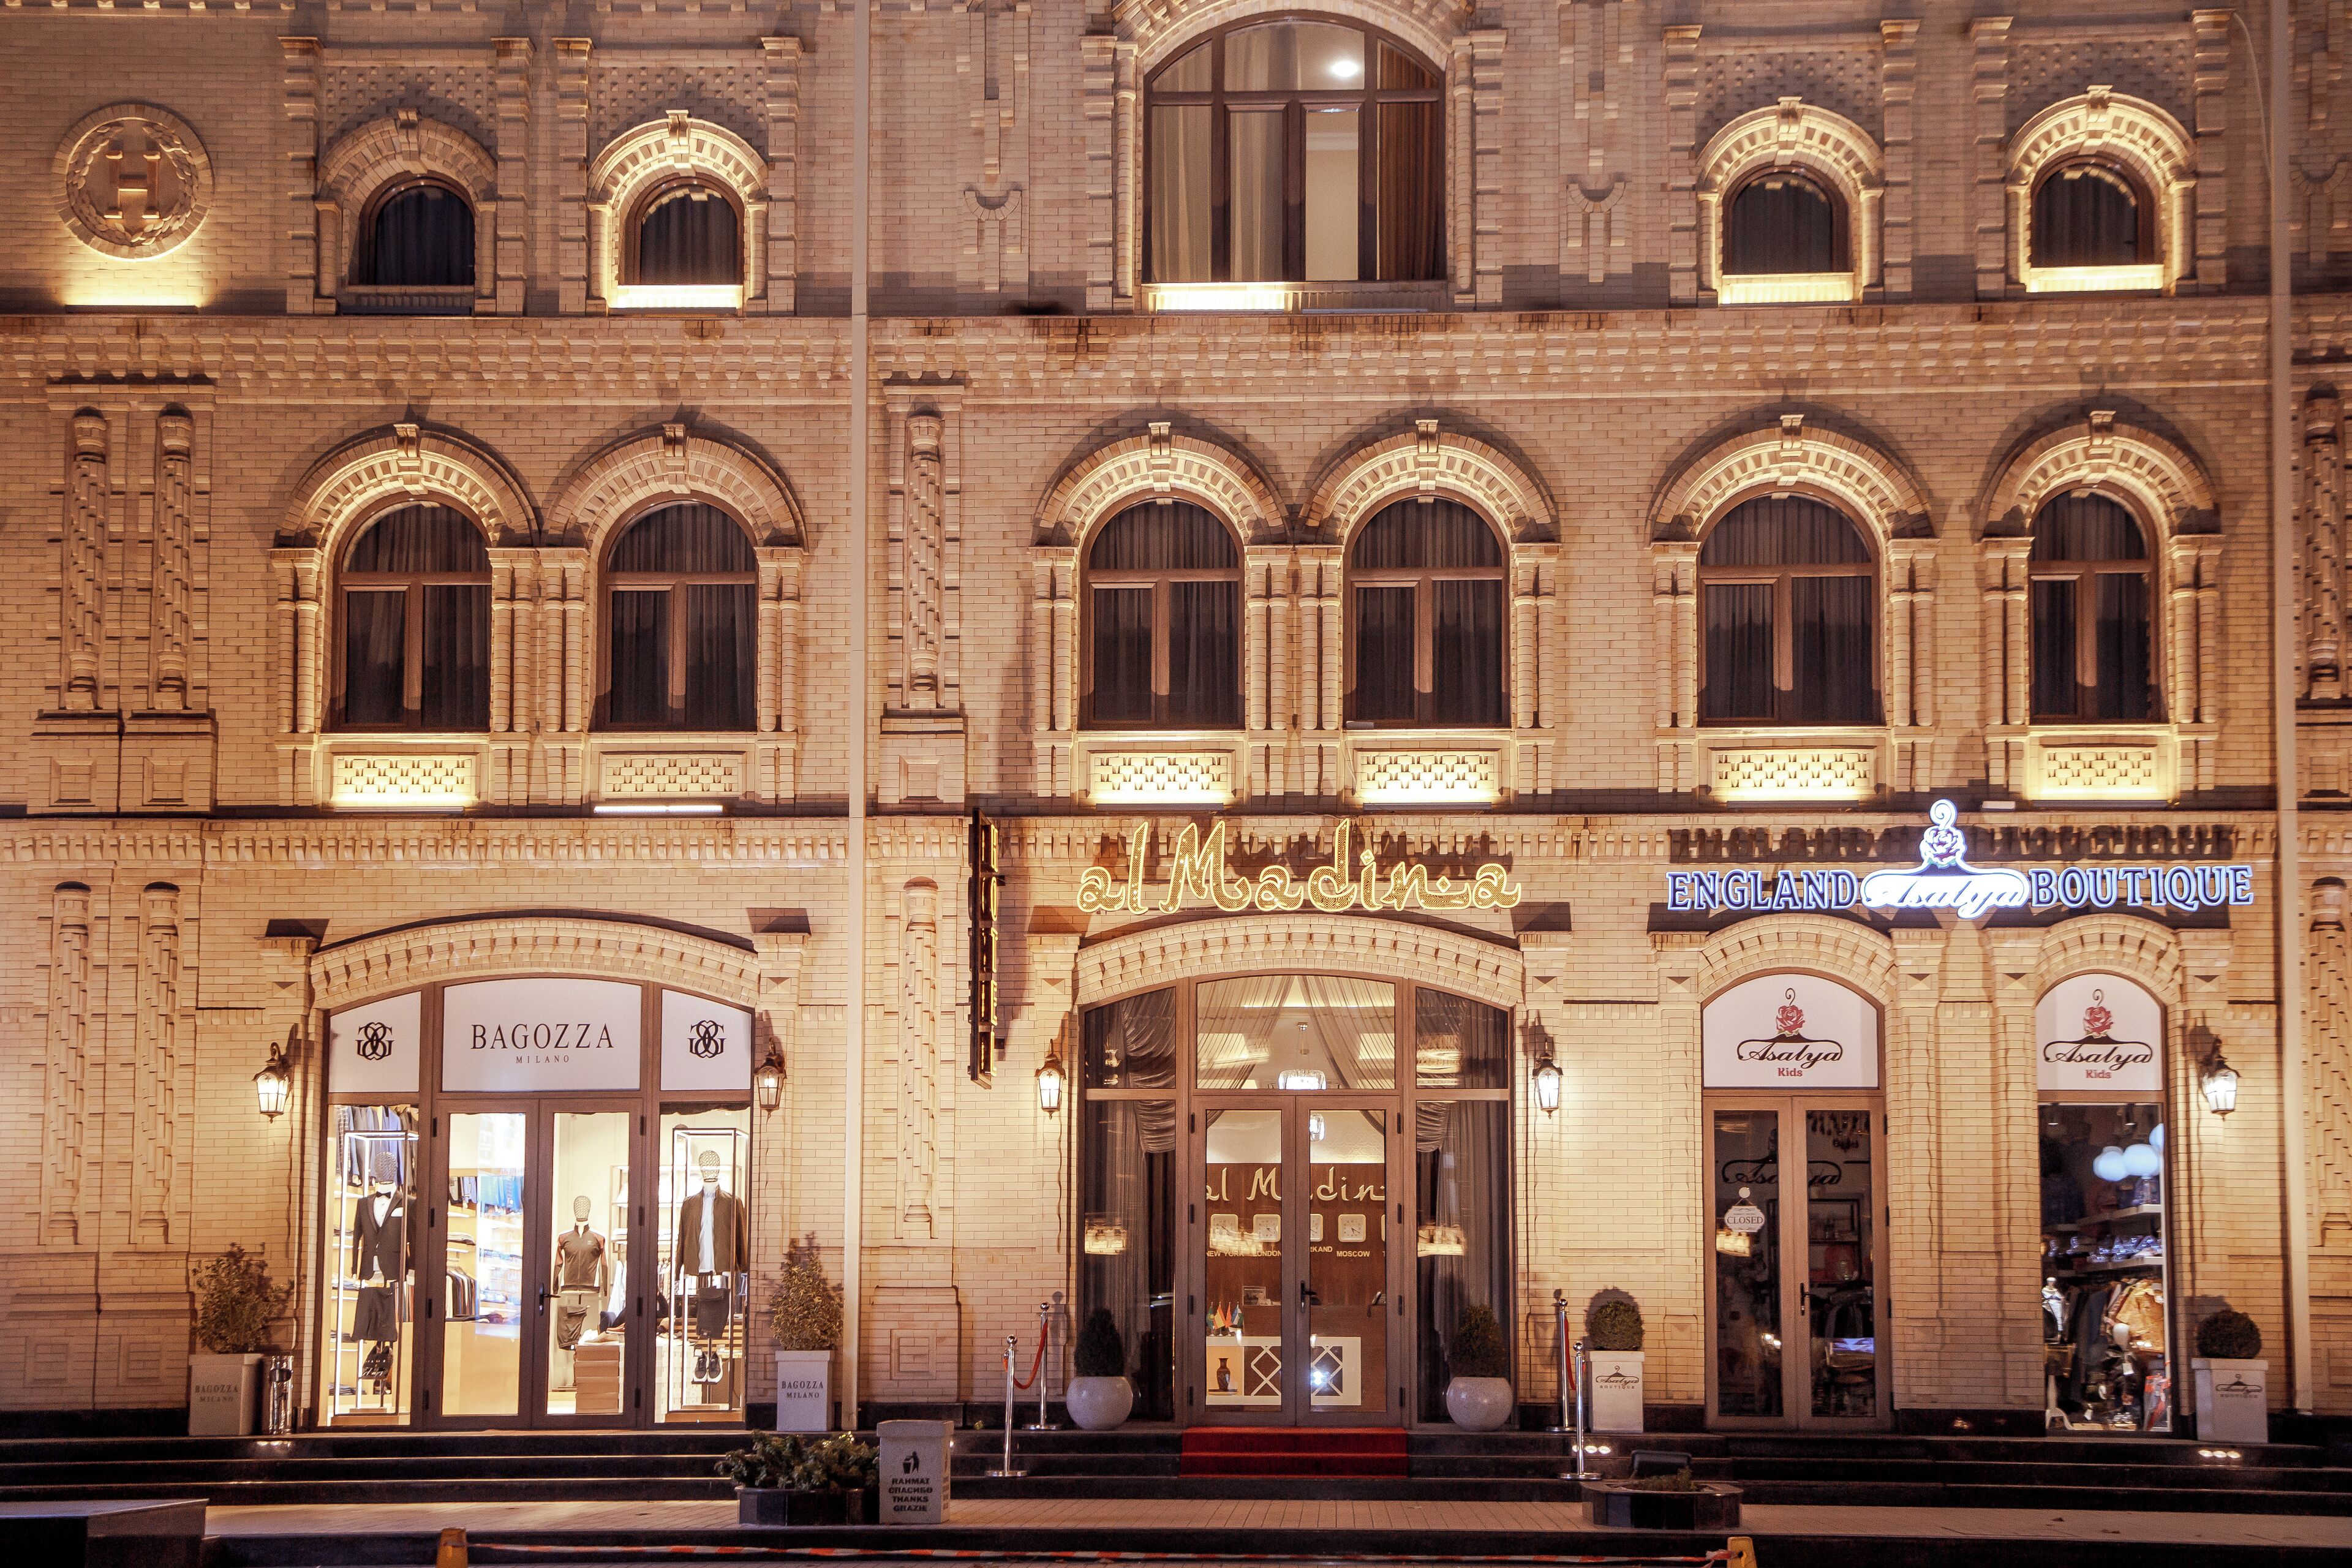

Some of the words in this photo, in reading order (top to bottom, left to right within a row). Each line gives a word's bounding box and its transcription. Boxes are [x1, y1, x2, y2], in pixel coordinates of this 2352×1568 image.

[1666, 869, 1860, 911] ENGLAND
[2029, 865, 2254, 911] BOUTIQUE
[471, 1023, 614, 1049] BAGOZZA
[516, 1055, 570, 1064] MILANO
[1738, 1042, 1840, 1069] Asalya
[2045, 1044, 2151, 1071] Asalya
[1777, 1068, 1803, 1077] Kids
[2085, 1069, 2112, 1079] Kids
[1246, 1166, 1385, 1202] Mdin
[195, 1384, 238, 1393] BAGOZZA
